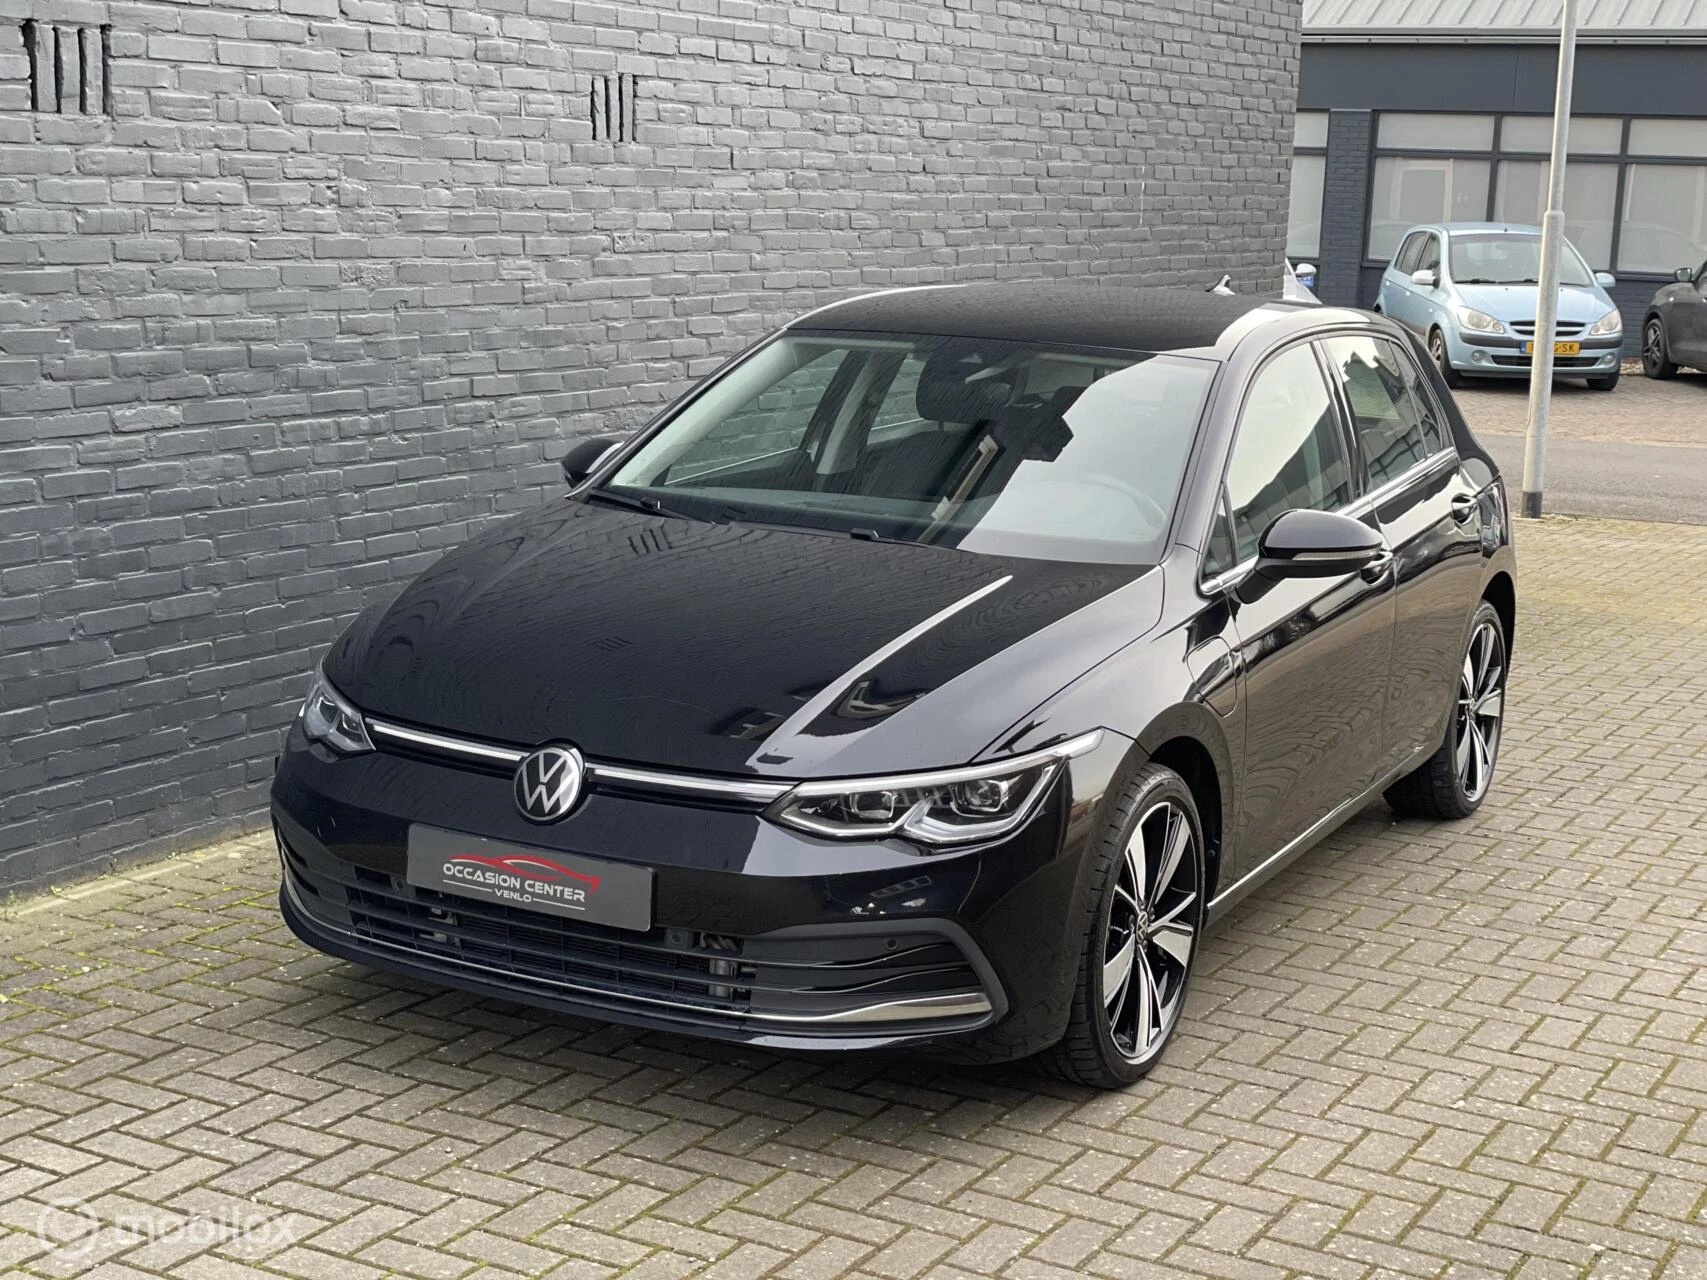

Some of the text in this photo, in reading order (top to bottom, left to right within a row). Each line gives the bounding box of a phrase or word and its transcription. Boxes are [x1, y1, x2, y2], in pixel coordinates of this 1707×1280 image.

[520, 750, 578, 815] VW
[443, 863, 586, 902] OCCASION CENTER
[494, 887, 532, 903] VENLO
